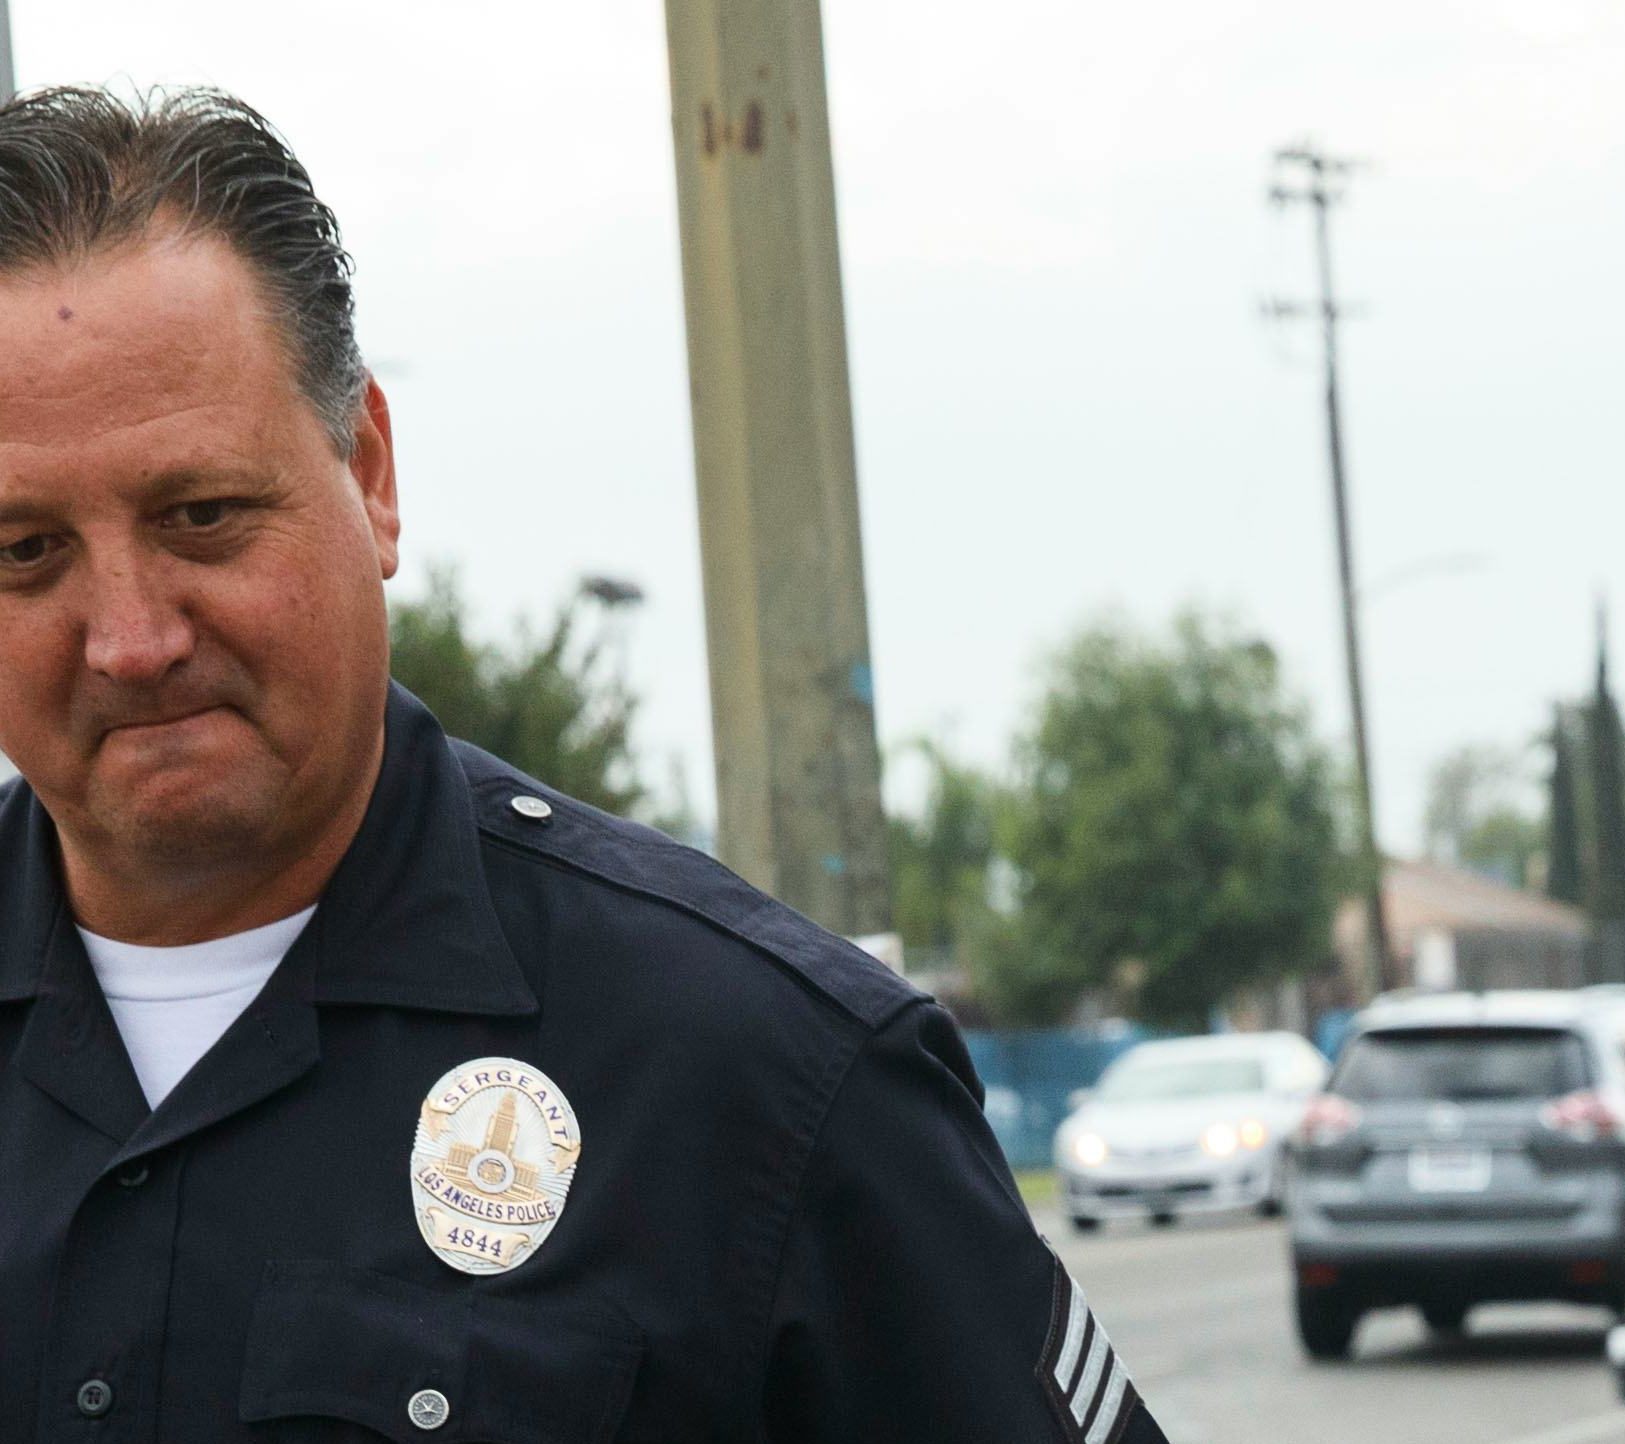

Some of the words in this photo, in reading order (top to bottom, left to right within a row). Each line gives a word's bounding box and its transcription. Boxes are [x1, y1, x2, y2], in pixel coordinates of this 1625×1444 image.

[443, 1069, 569, 1140] SERGEANT
[418, 1166, 441, 1192] LOS
[443, 1186, 503, 1220] ANGELES
[507, 1199, 556, 1221] POLICE
[446, 1226, 503, 1258] 4844
